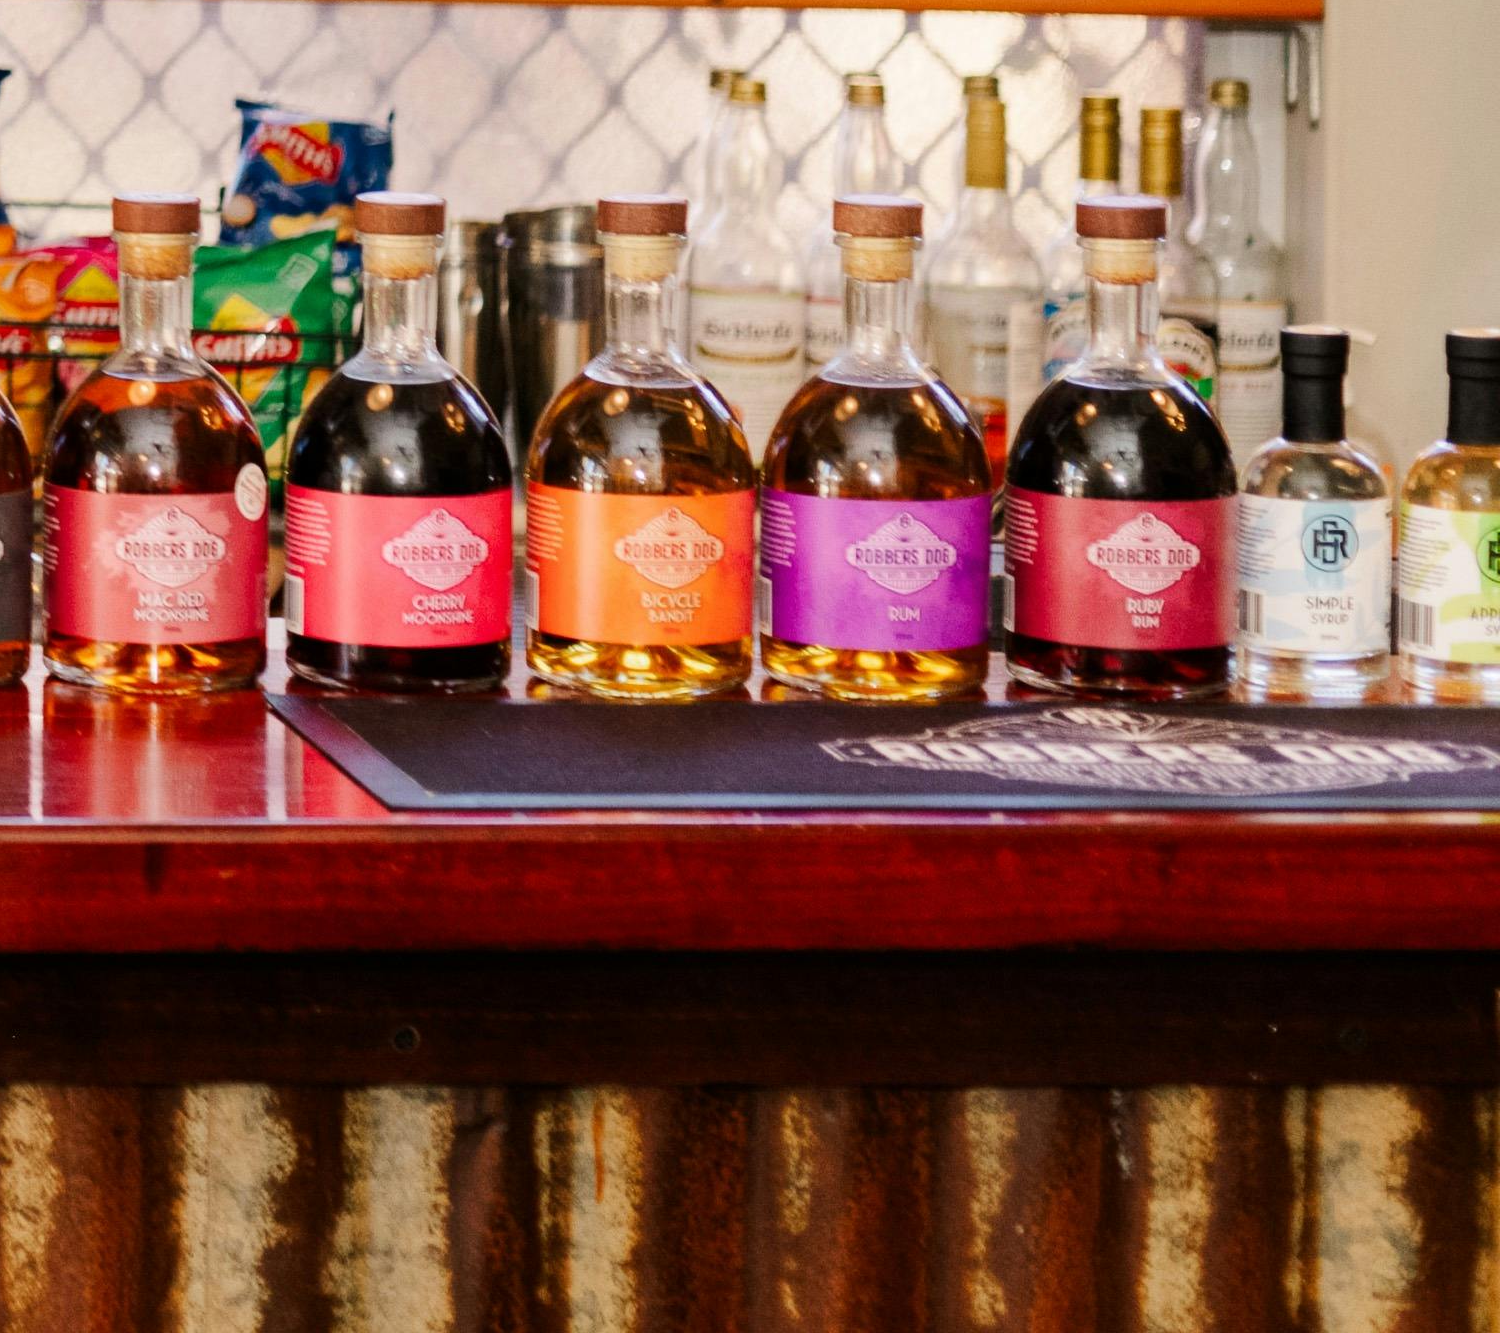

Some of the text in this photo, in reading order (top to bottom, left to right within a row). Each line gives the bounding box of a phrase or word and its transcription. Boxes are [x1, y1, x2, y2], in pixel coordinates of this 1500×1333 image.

[123, 540, 219, 559] ROBBERS DOG
[392, 542, 483, 562] ROBBERS DOG
[622, 541, 718, 560] ROBBERS DOG
[854, 547, 951, 566] ROBBERS DOG
[1096, 547, 1194, 566] ROBBERS DOG
[137, 591, 206, 608] MAC RED
[411, 593, 467, 611] CHERRY
[640, 590, 702, 609] BICYCLE
[1124, 597, 1165, 615] RUBY
[1306, 595, 1356, 611] SIMPLE
[132, 606, 210, 623] MOONSHINE
[401, 609, 476, 625] MOONSHINE
[648, 608, 695, 624] BANDIT
[887, 604, 922, 623] RUM
[1310, 611, 1350, 625] SYRUP
[1470, 607, 1500, 621] APP
[870, 740, 1452, 767] ROBBERS DOG
